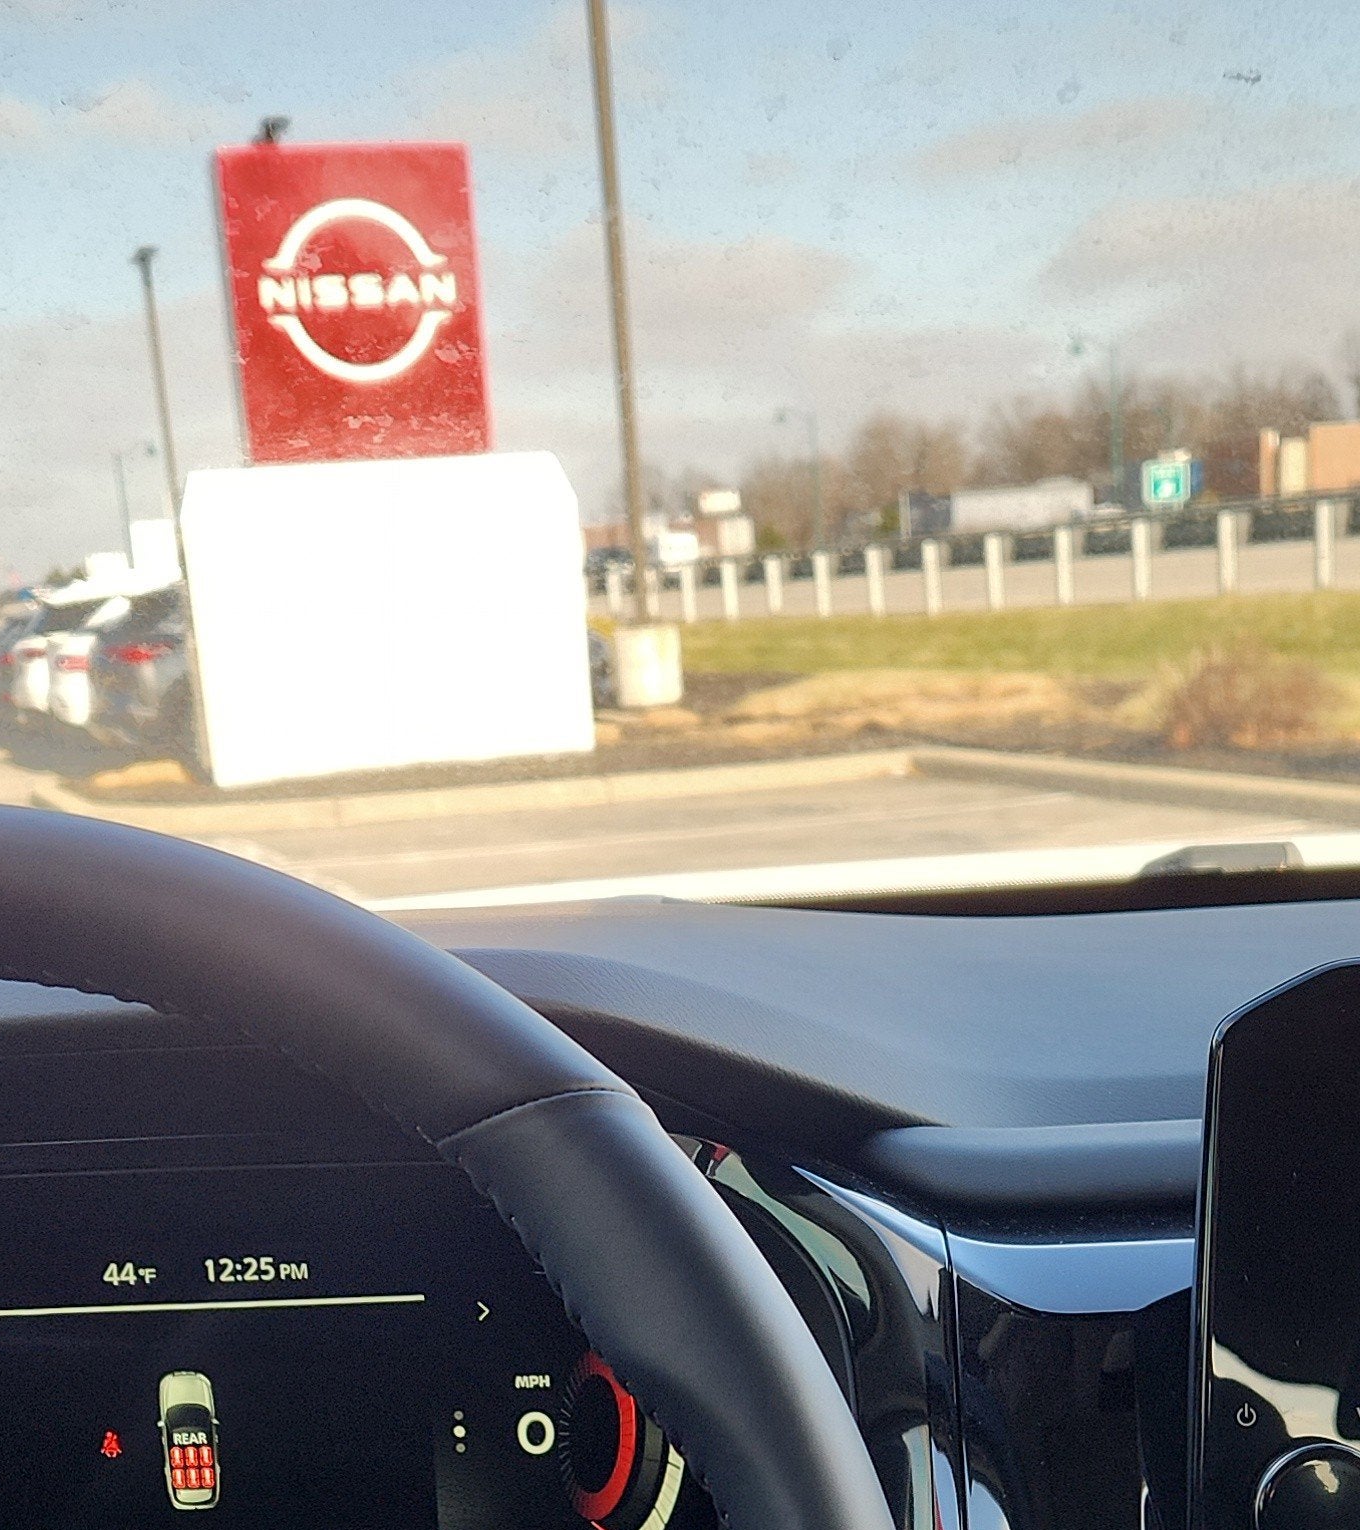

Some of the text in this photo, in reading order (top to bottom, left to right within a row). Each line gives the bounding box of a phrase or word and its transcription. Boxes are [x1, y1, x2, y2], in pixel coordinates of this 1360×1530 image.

[257, 272, 456, 311] NISSAN
[204, 1256, 276, 1283] 12:25
[279, 1262, 309, 1281] PM
[515, 1374, 551, 1389] MPH
[172, 1432, 208, 1446] REAR
